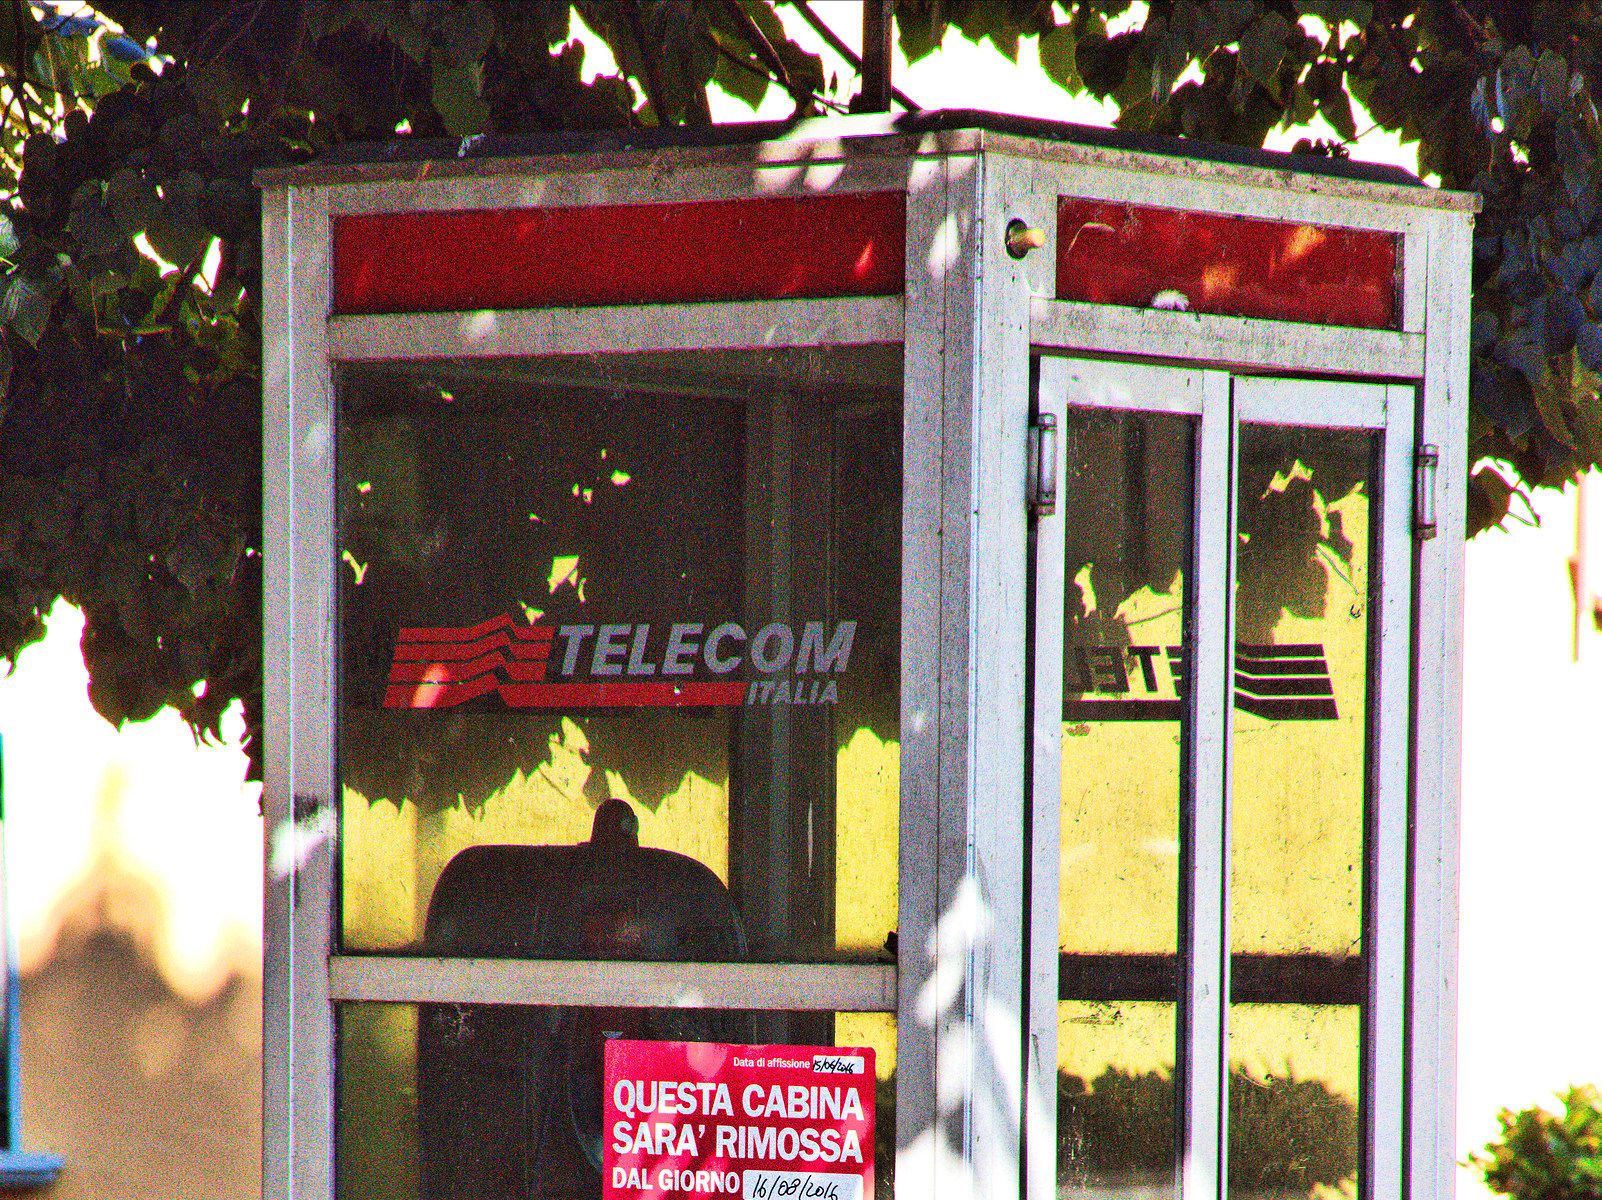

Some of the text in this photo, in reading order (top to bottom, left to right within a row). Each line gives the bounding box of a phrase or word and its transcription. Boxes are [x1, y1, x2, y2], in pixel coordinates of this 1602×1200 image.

[558, 620, 858, 676] TELECOM
[747, 680, 839, 705] ITALIA
[733, 1057, 811, 1069] Data di affissione
[613, 1079, 865, 1121] QUESTA CABINA
[612, 1120, 864, 1164] SARA' RIMOSSA
[612, 1167, 740, 1194] DAL GIORNO
